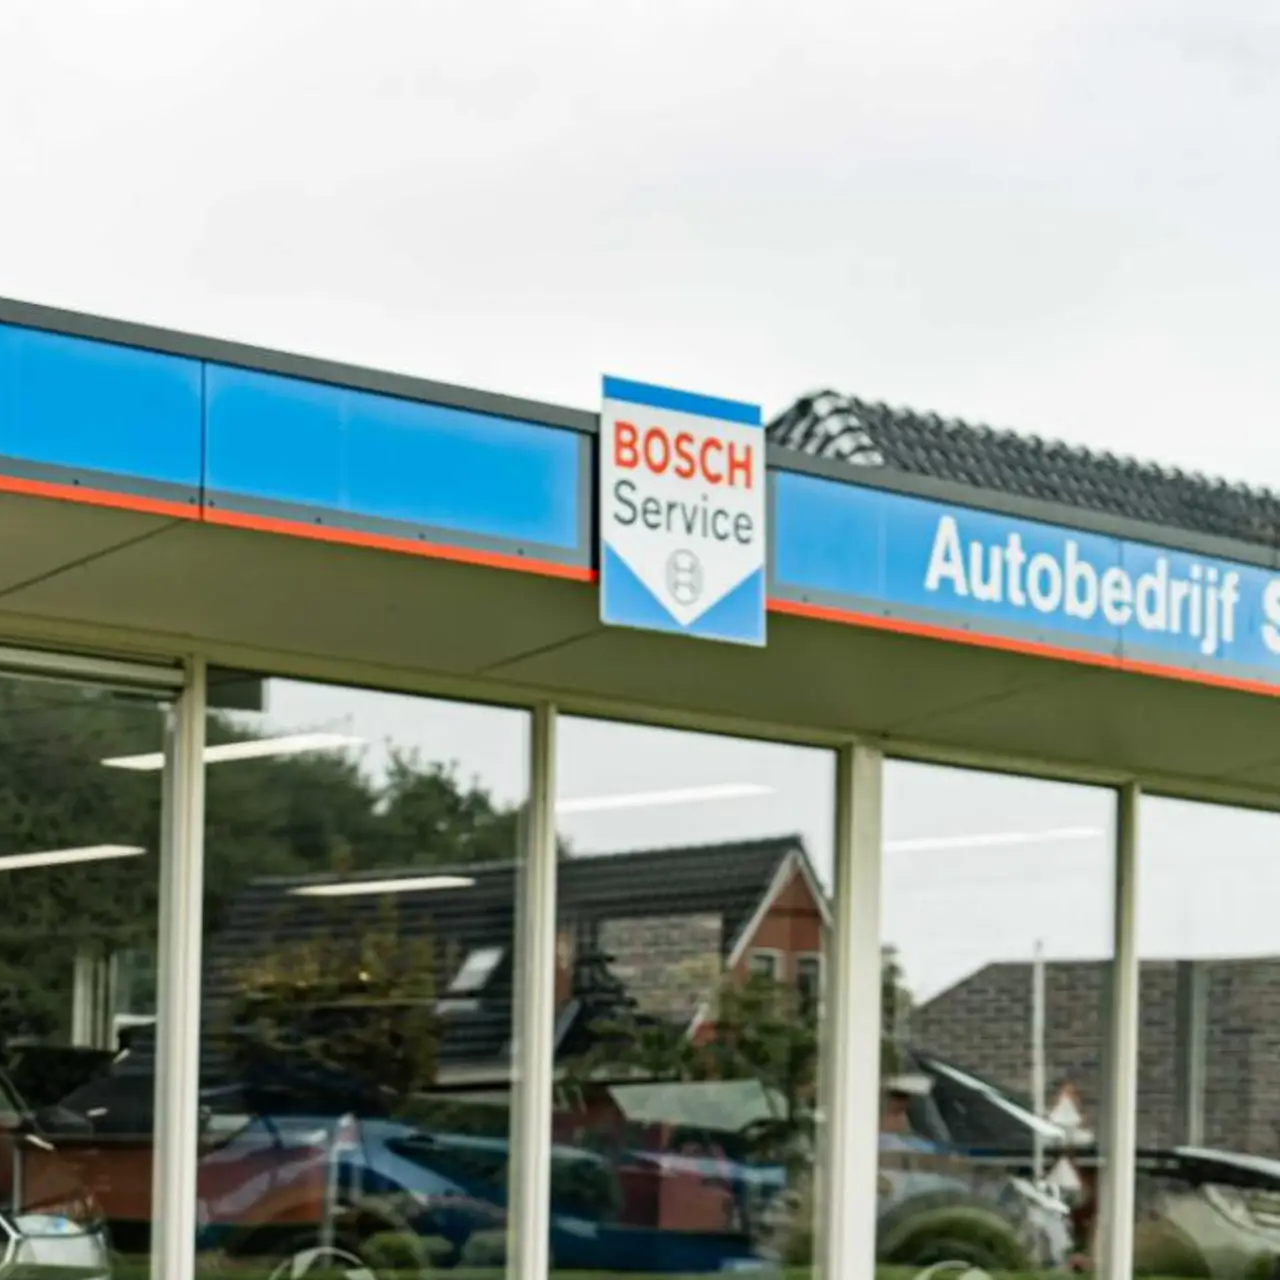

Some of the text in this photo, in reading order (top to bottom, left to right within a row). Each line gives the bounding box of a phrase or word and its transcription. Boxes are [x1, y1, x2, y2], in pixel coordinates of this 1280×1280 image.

[612, 420, 754, 490] BOSCH
[611, 479, 754, 546] Service
[924, 515, 1239, 656] Autobedrijf
